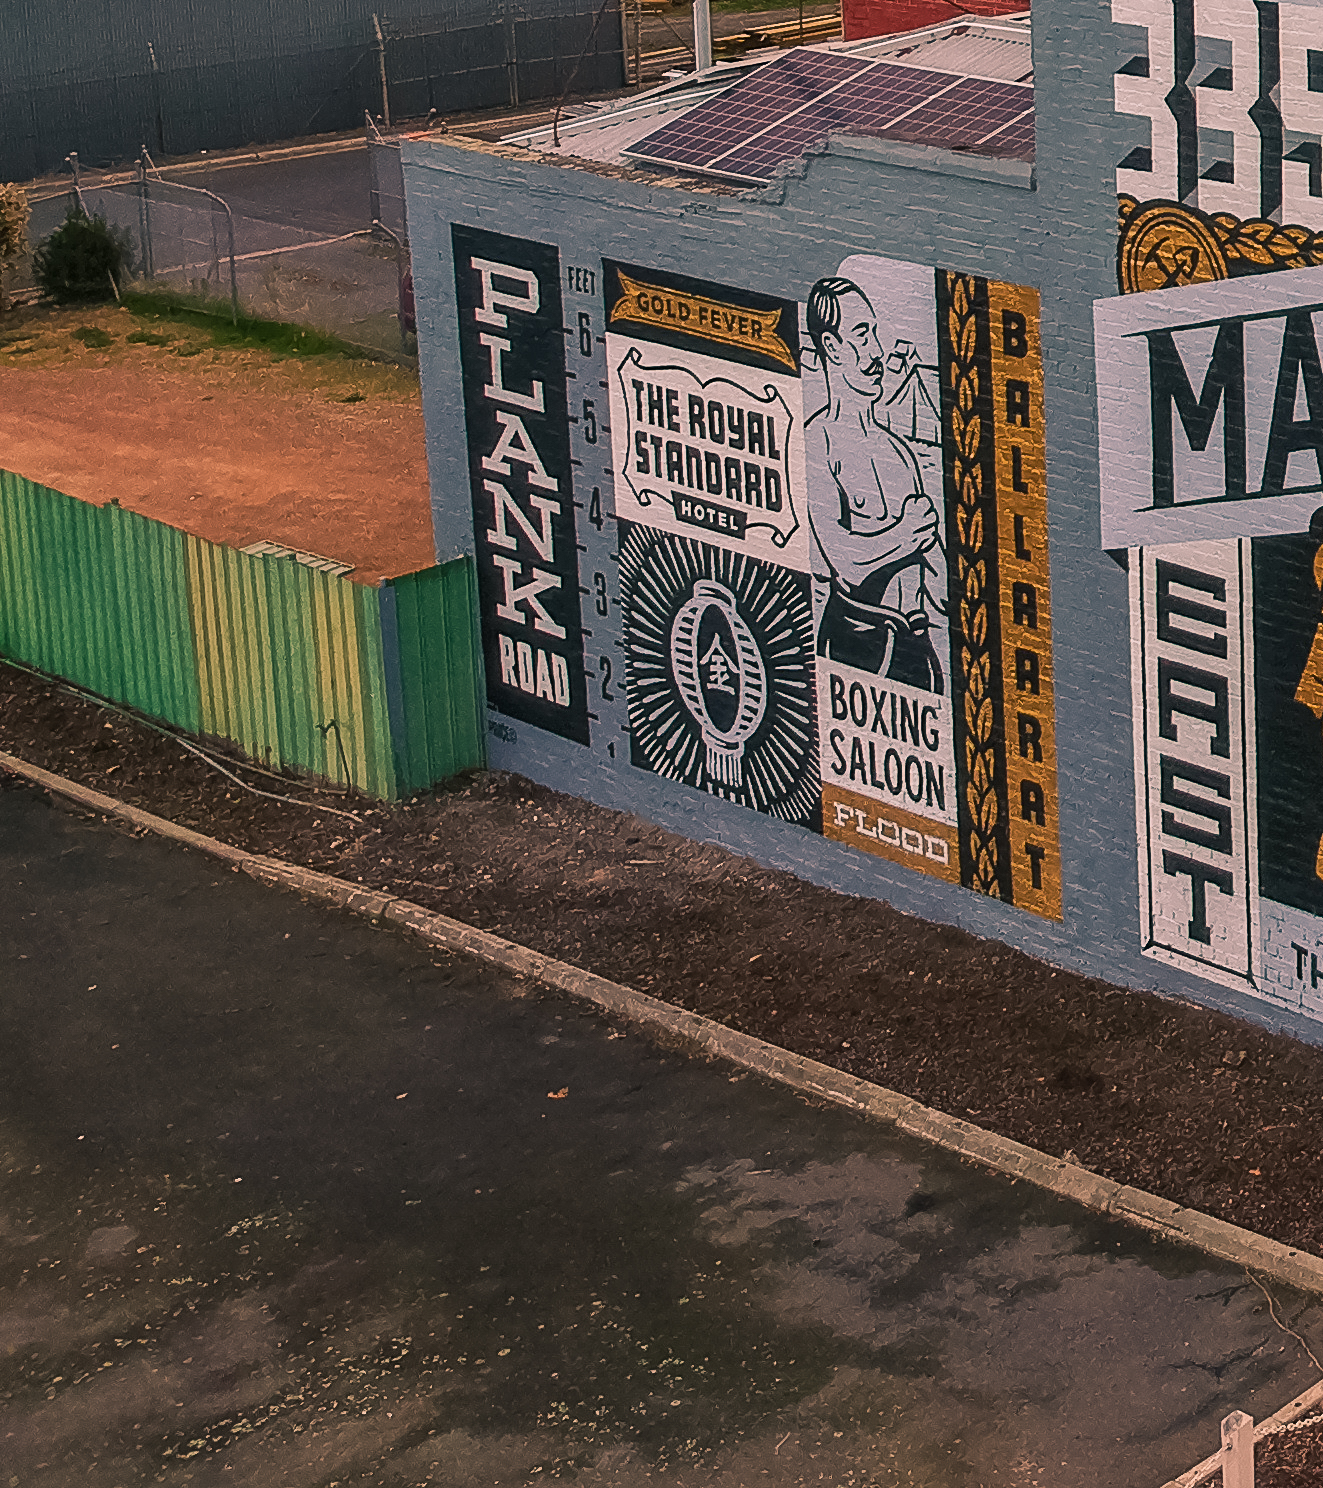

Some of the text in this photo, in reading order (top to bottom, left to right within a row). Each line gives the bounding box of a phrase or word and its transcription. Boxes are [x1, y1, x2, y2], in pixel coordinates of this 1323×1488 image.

[567, 266, 596, 297] FEET
[577, 311, 592, 358] 6
[636, 292, 763, 340] GOLD FEVER
[471, 256, 567, 639] PLANK
[582, 398, 598, 445] 5
[631, 378, 781, 461] THE ROYAL
[634, 430, 783, 513] STANDARD
[589, 486, 604, 532] 4
[680, 499, 740, 532] HOTEL
[593, 571, 608, 617] 3
[1000, 308, 1047, 891] BALLARAT
[499, 633, 571, 708] ROAD
[600, 655, 614, 702] 2
[700, 631, 741, 694] 金
[829, 673, 940, 752] BOXING
[606, 741, 616, 759] 1
[829, 728, 946, 812] SALOON
[1156, 558, 1237, 946] EAST
[833, 801, 949, 866] FLOOD
